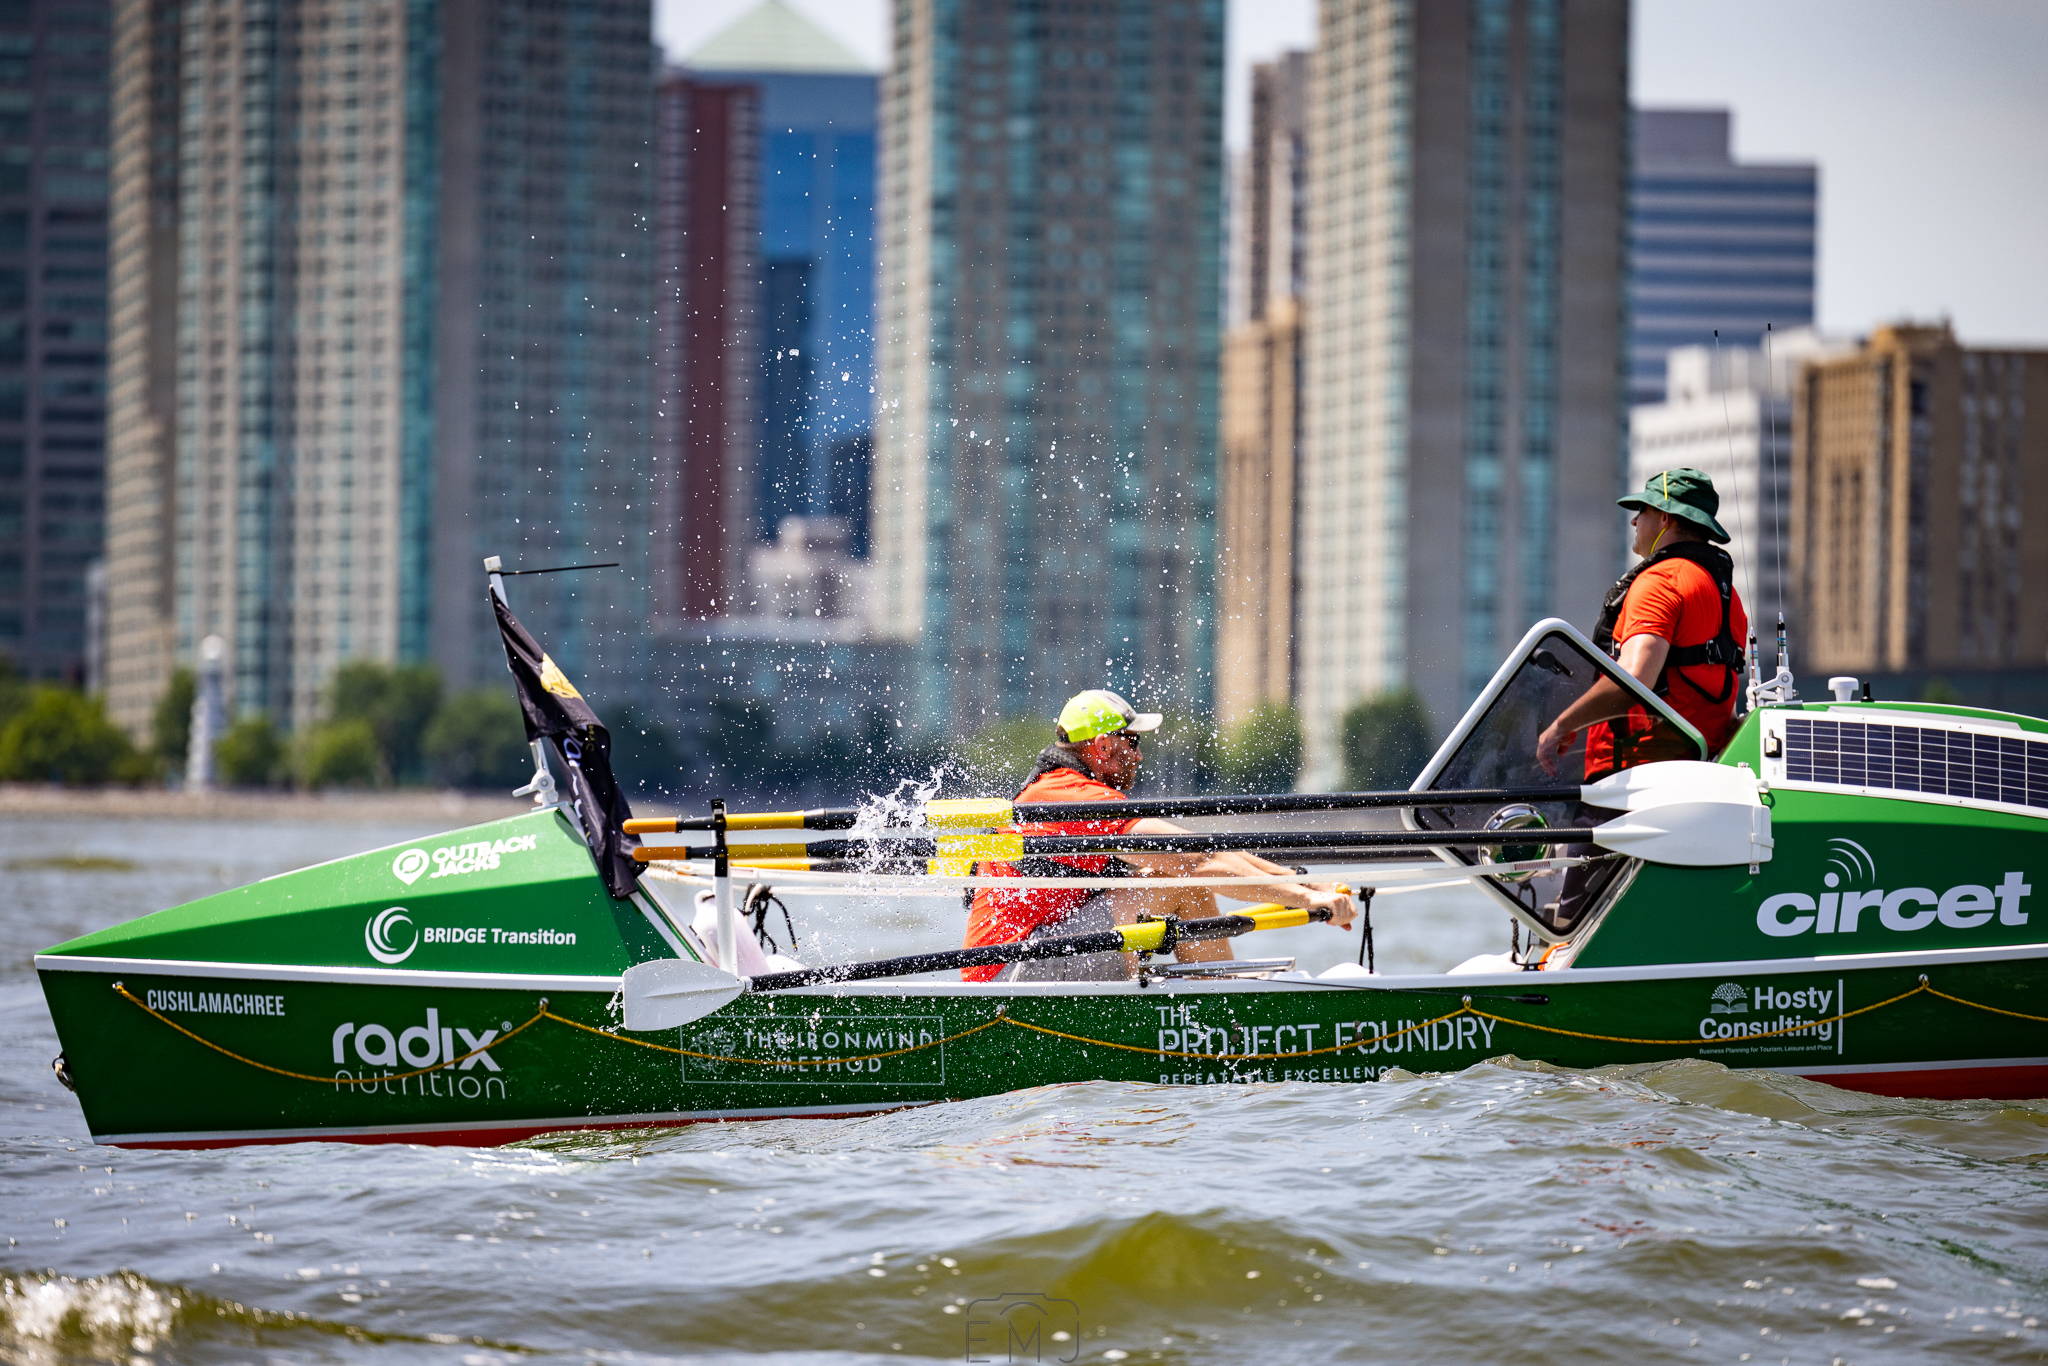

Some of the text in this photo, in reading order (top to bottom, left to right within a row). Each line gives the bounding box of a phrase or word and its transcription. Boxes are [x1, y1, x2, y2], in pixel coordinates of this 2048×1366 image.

[432, 834, 537, 863] OUTBACK
[430, 854, 501, 878] JACKS
[1756, 871, 2032, 937] circet
[424, 927, 577, 946] BRIDGE Transition
[147, 989, 286, 1017] CUSHLAMACHREE
[1754, 986, 1833, 1014] Hosty
[1155, 1005, 1199, 1027] THE
[1699, 1015, 1833, 1042] Consulting
[743, 1031, 933, 1049] THE IRONMIND
[1158, 1016, 1497, 1062] PROJECT FOUNDRY
[775, 1056, 883, 1073] METHOD
[1284, 1065, 1400, 1081] EXCELLENC
[335, 1069, 507, 1100] nutrition
